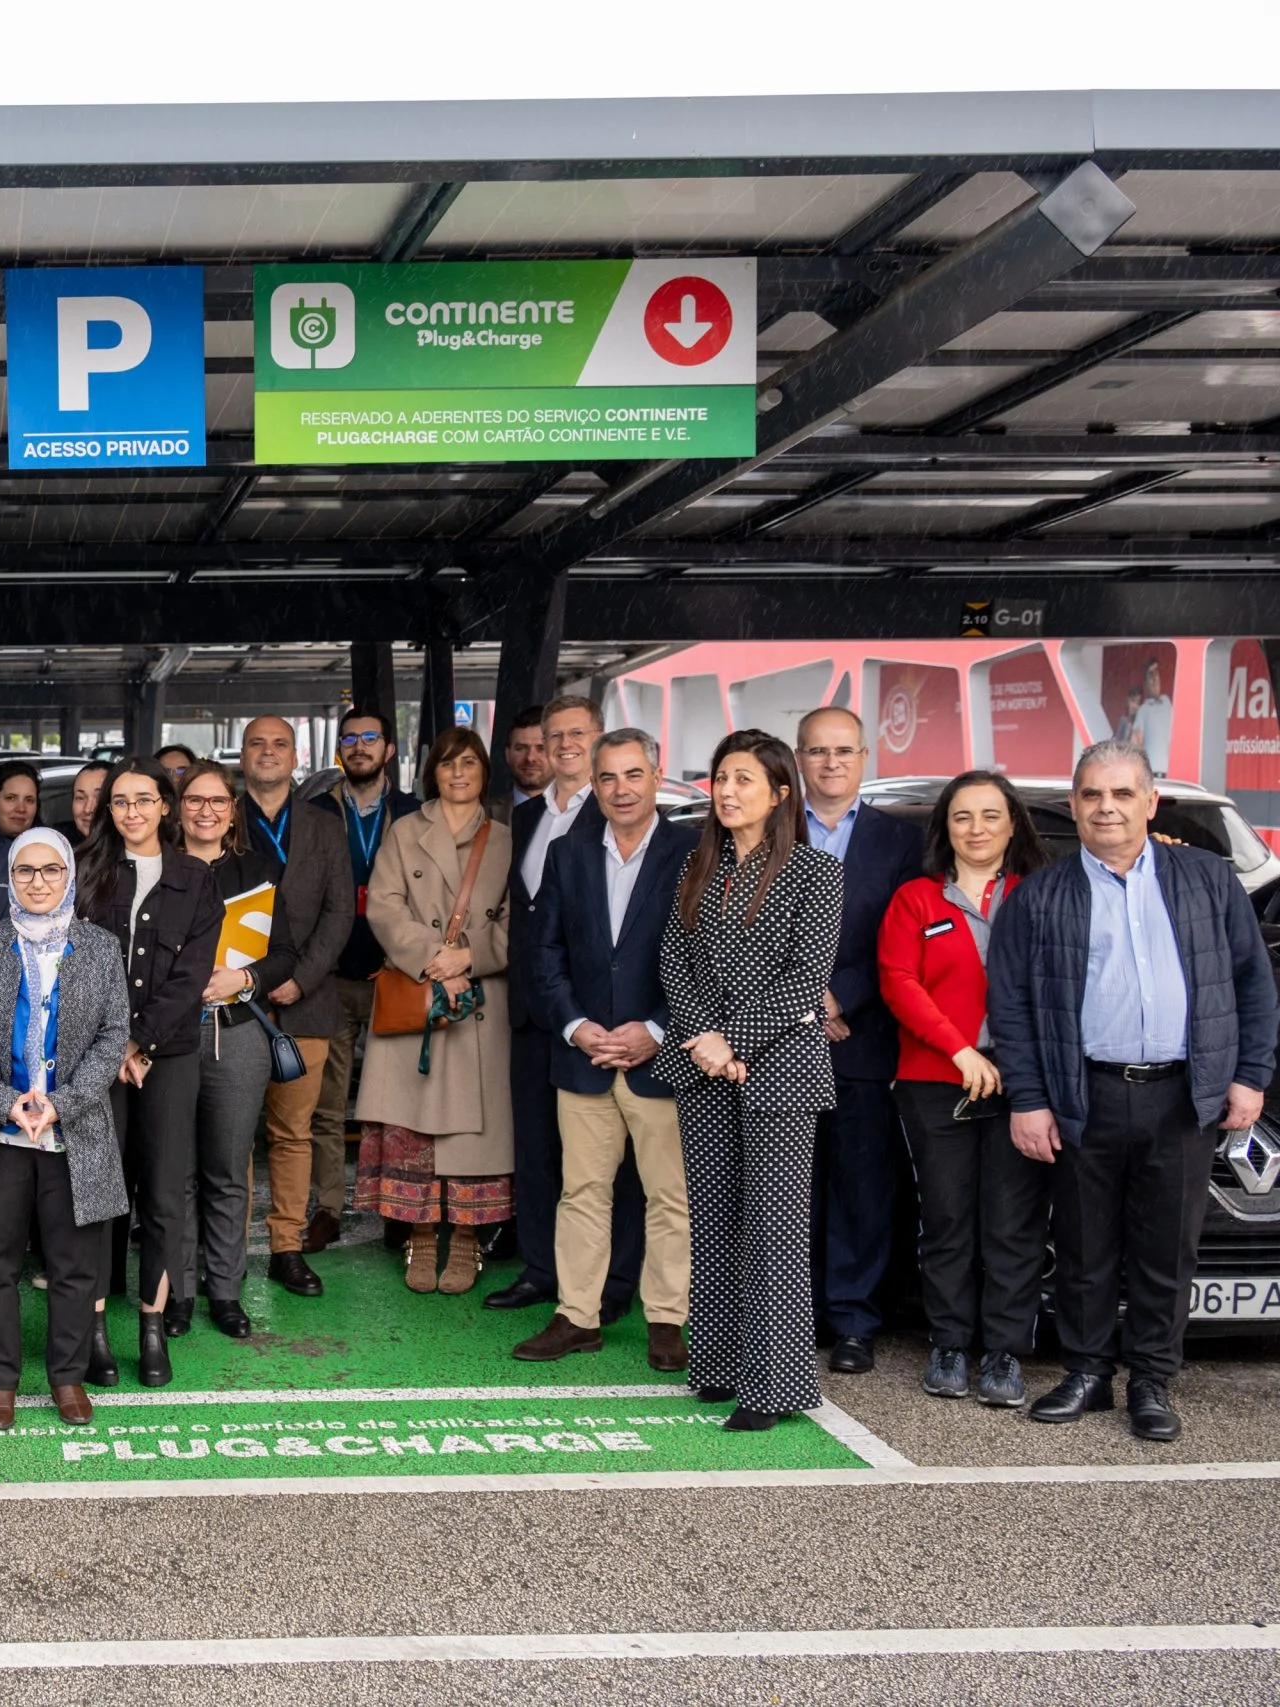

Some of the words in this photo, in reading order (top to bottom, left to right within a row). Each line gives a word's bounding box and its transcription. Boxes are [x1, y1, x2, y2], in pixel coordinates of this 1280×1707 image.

[385, 300, 574, 325] CONTINENTE
[417, 328, 542, 350] Plug&Charge
[57, 296, 152, 411] P
[301, 411, 393, 425] RESERVADO
[397, 411, 408, 424] A
[412, 410, 503, 424] ADERENTES
[507, 409, 530, 424] DO
[534, 409, 600, 426] SERVIÇO
[605, 407, 707, 422] CONTINENTE
[317, 430, 437, 444] PLUG&CHARGE
[442, 430, 478, 444] COM
[484, 426, 544, 443] CARTÃO
[549, 428, 646, 442] CONTINENTE
[651, 427, 660, 441] E
[664, 427, 690, 441] V.E.
[23, 441, 101, 458] ACESSO
[106, 439, 190, 456] PRIVADO
[962, 615, 988, 625] 2.10
[995, 608, 1042, 626] G-01
[108, 1424, 179, 1437] para
[191, 1424, 210, 1432] o
[358, 1420, 397, 1430] de
[62, 1431, 653, 1461] PLUG&CHARGE
